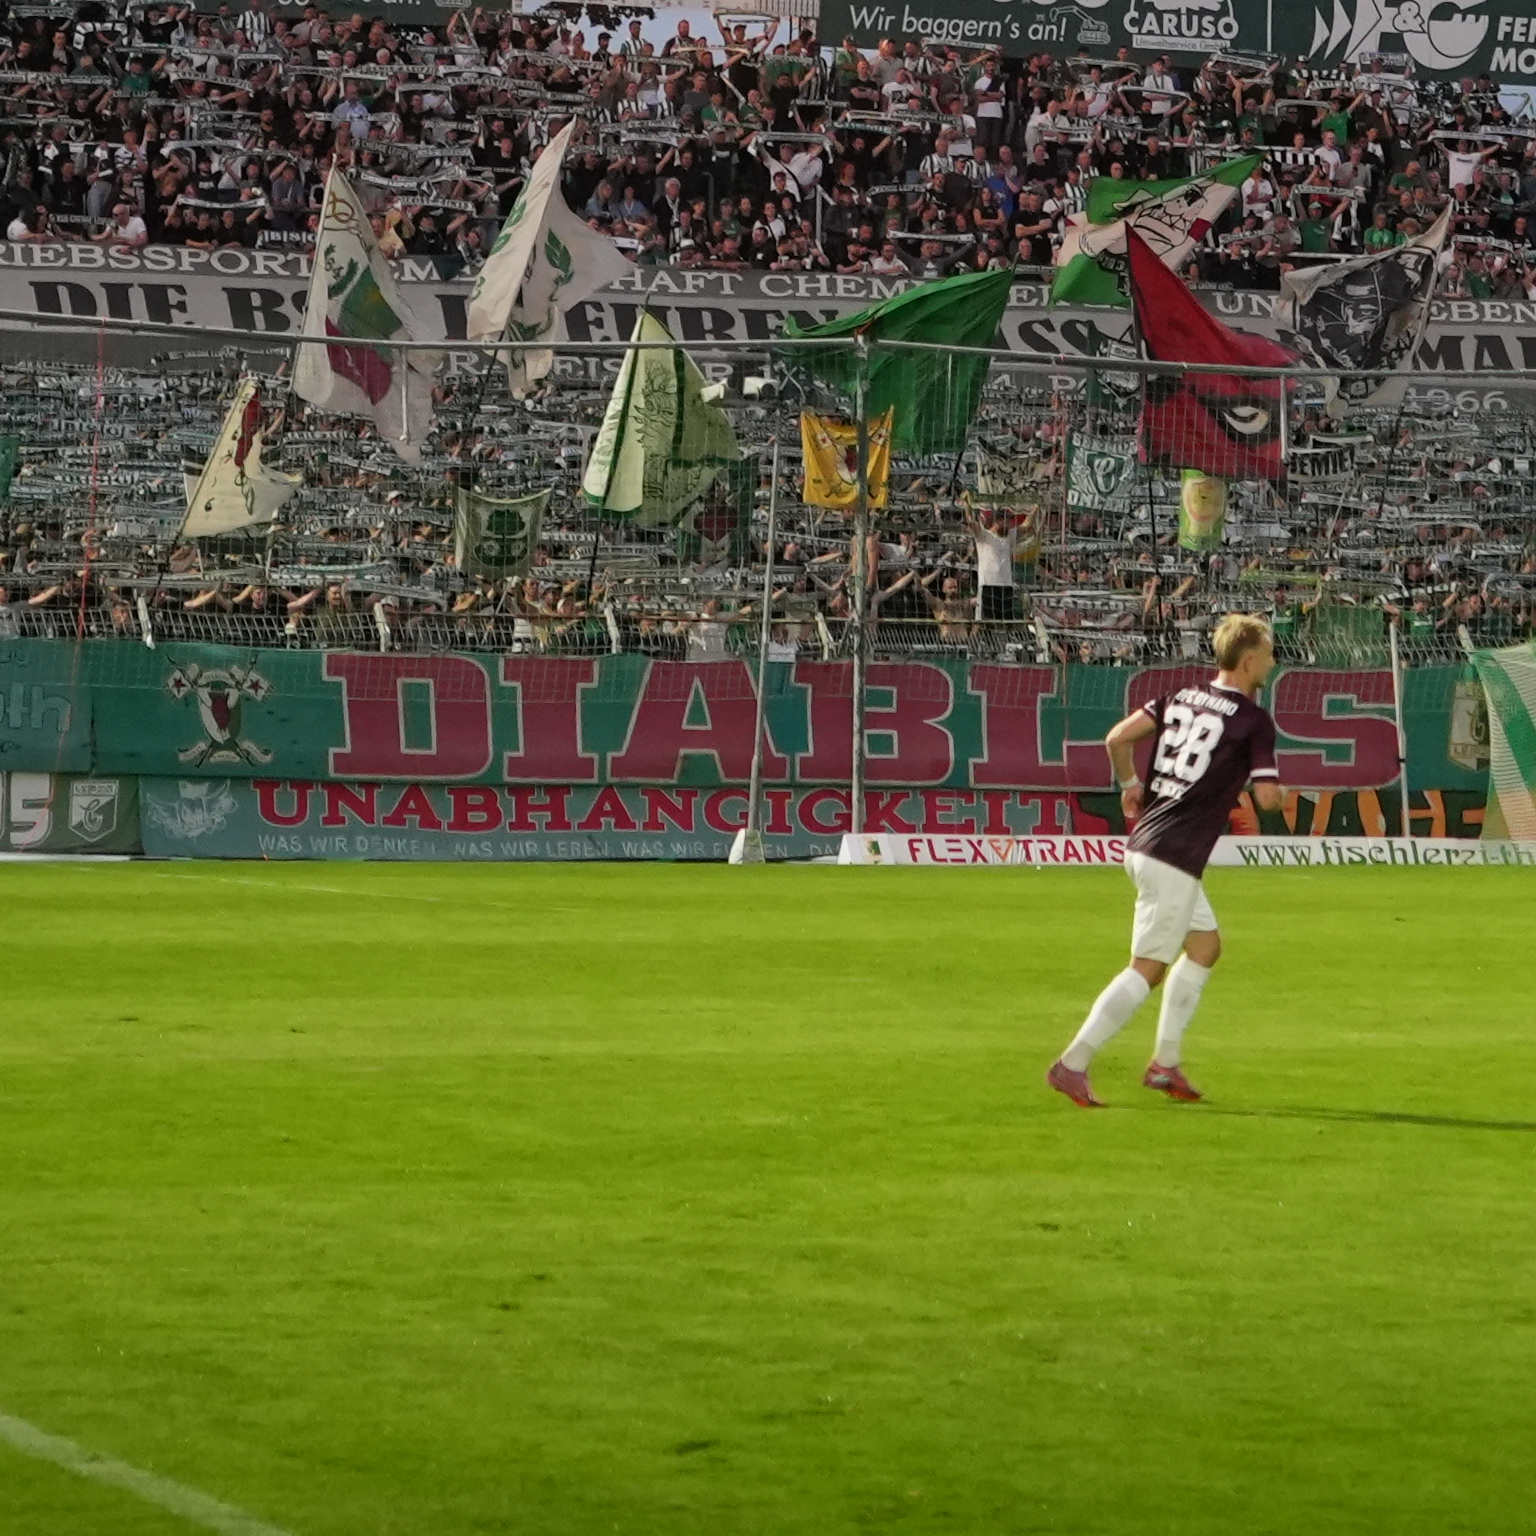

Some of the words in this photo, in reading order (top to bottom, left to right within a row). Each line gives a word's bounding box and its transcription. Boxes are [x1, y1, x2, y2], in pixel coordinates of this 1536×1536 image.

[849, 4, 896, 31] Wir
[902, 5, 1021, 41] baggern's
[1027, 16, 1067, 42] an!
[1123, 11, 1239, 40] CARUSO
[29, 280, 189, 327] DIE
[1194, 691, 1239, 717] DYNAMO
[1154, 705, 1225, 783] 28
[257, 834, 302, 853] WAS
[310, 834, 349, 853] WIR
[499, 841, 539, 857] WIR
[621, 841, 666, 858] WAS
